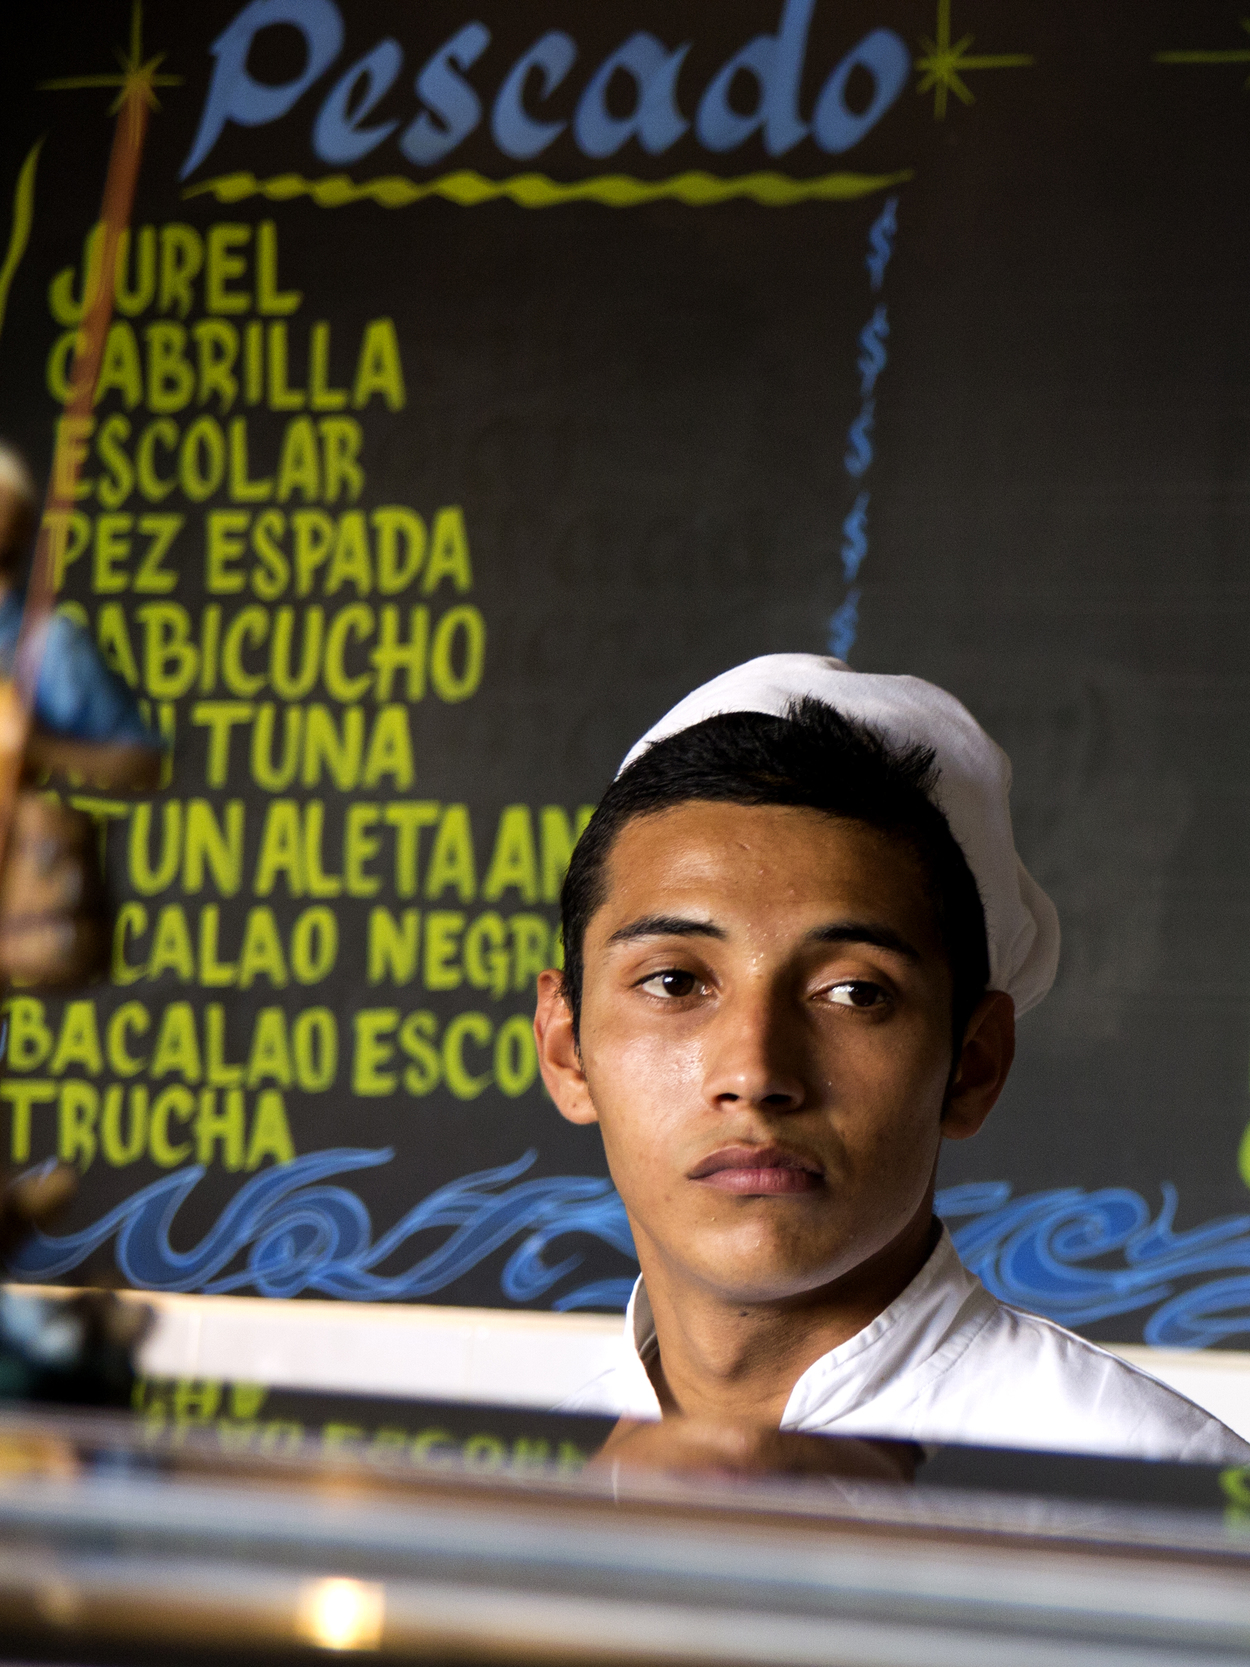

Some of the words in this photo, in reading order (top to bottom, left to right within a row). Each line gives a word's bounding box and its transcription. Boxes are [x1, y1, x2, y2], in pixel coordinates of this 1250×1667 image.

[182, 0, 908, 176] Pescado
[48, 219, 301, 328] JUREL
[47, 317, 405, 413] CABRILLA
[56, 414, 365, 508] ESCOLAR
[42, 510, 186, 595] PEZ
[206, 505, 472, 601] ESPADA
[54, 600, 490, 701] ABICUCHO
[191, 700, 415, 792] TUNA
[42, 790, 246, 898] TUN
[10, 902, 340, 990] CALAO
[367, 906, 566, 996] NEGR
[5, 996, 340, 1094] BACALAO
[352, 1007, 540, 1099] ESCO
[0, 1079, 298, 1174] TRUCHA
